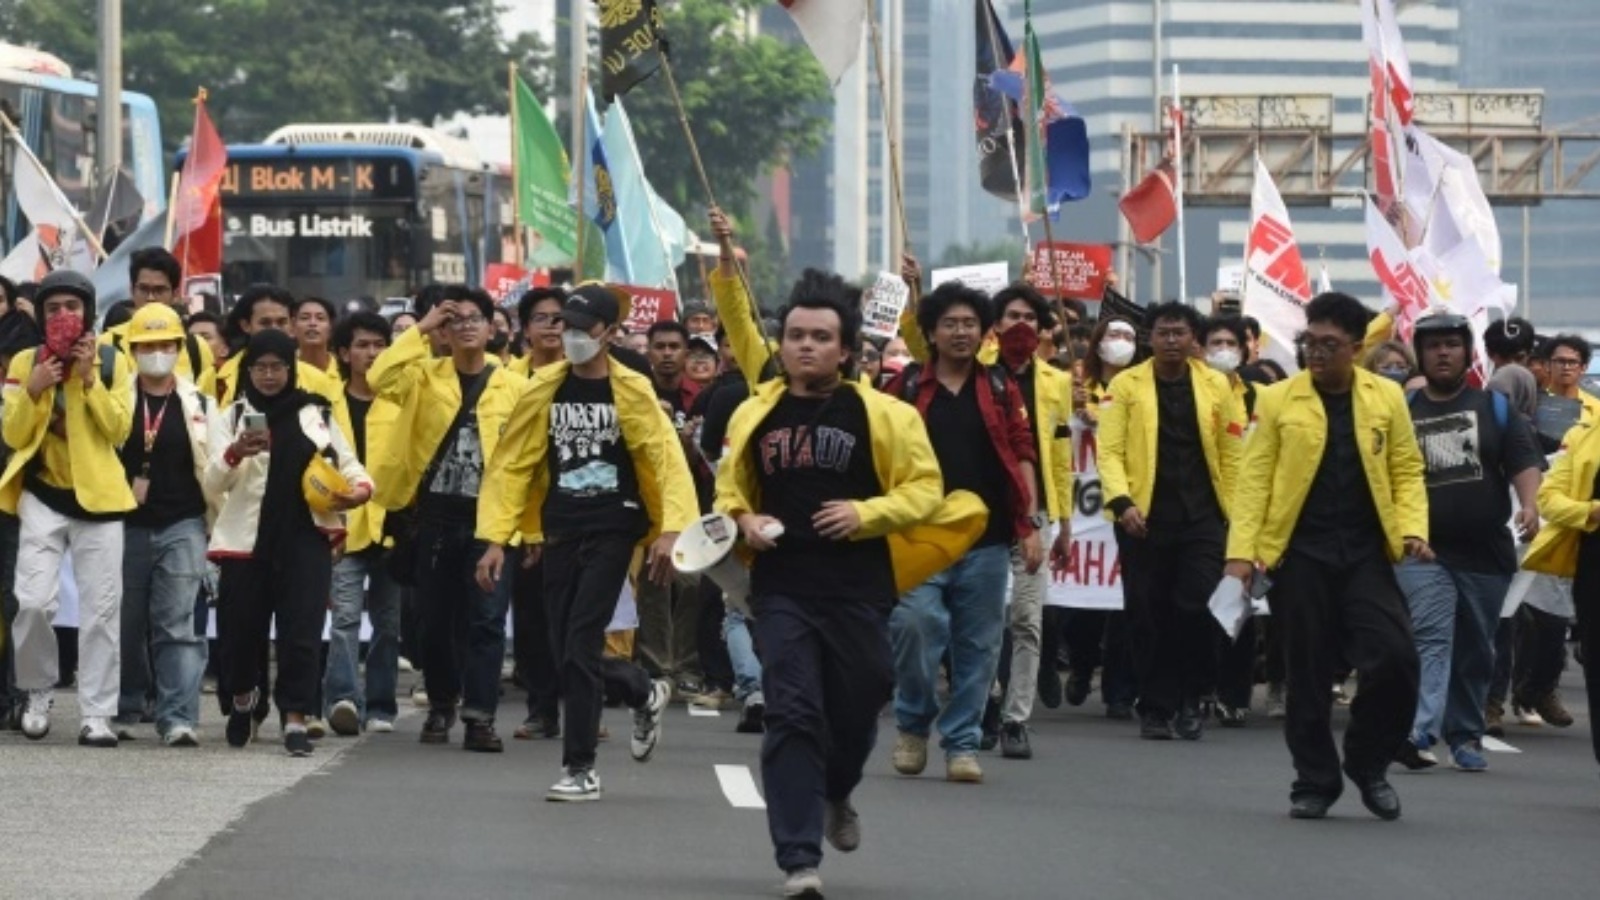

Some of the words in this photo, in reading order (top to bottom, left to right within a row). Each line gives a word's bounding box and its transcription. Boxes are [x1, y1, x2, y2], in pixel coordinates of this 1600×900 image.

[252, 165, 304, 190] Blok
[311, 165, 335, 190] M
[355, 164, 374, 190] K
[251, 214, 296, 237] Bus
[300, 213, 373, 237] Listrik
